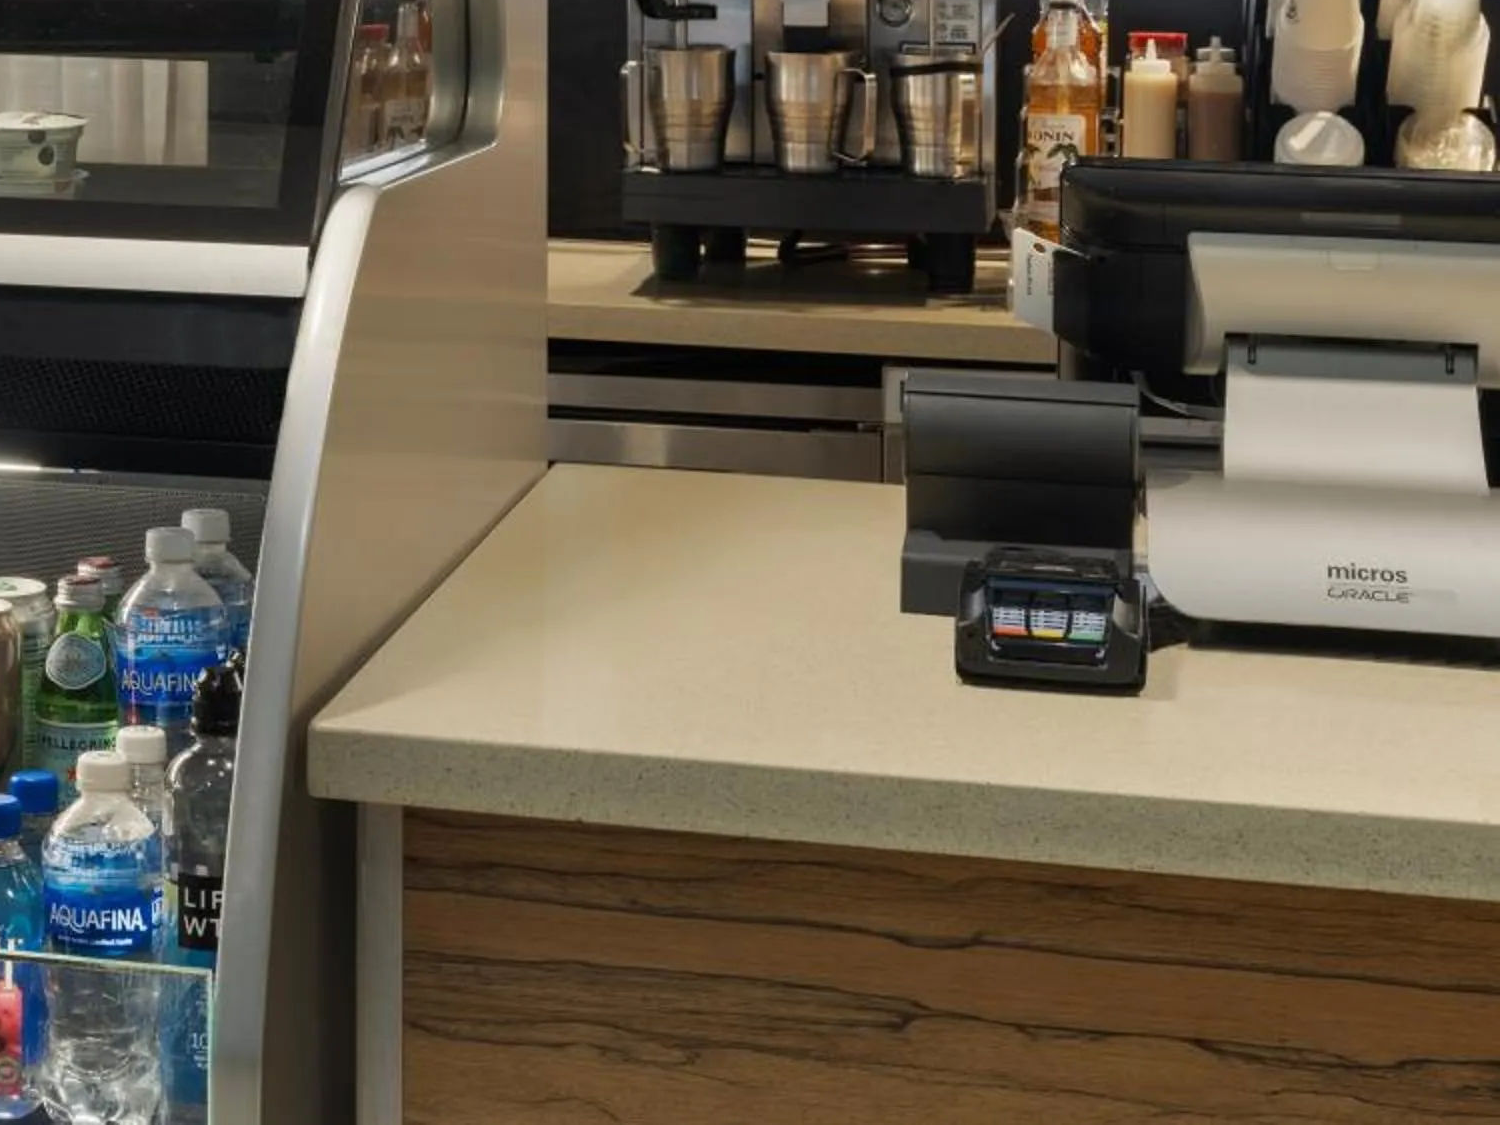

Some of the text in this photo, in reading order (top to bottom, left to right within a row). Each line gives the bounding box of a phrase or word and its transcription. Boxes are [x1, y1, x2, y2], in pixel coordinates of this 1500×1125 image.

[1327, 562, 1408, 583] micros
[1327, 587, 1410, 603] ORACLE
[121, 669, 200, 695] AQUAFIN
[49, 902, 147, 933] AQUAFINA
[184, 915, 222, 937] WT
